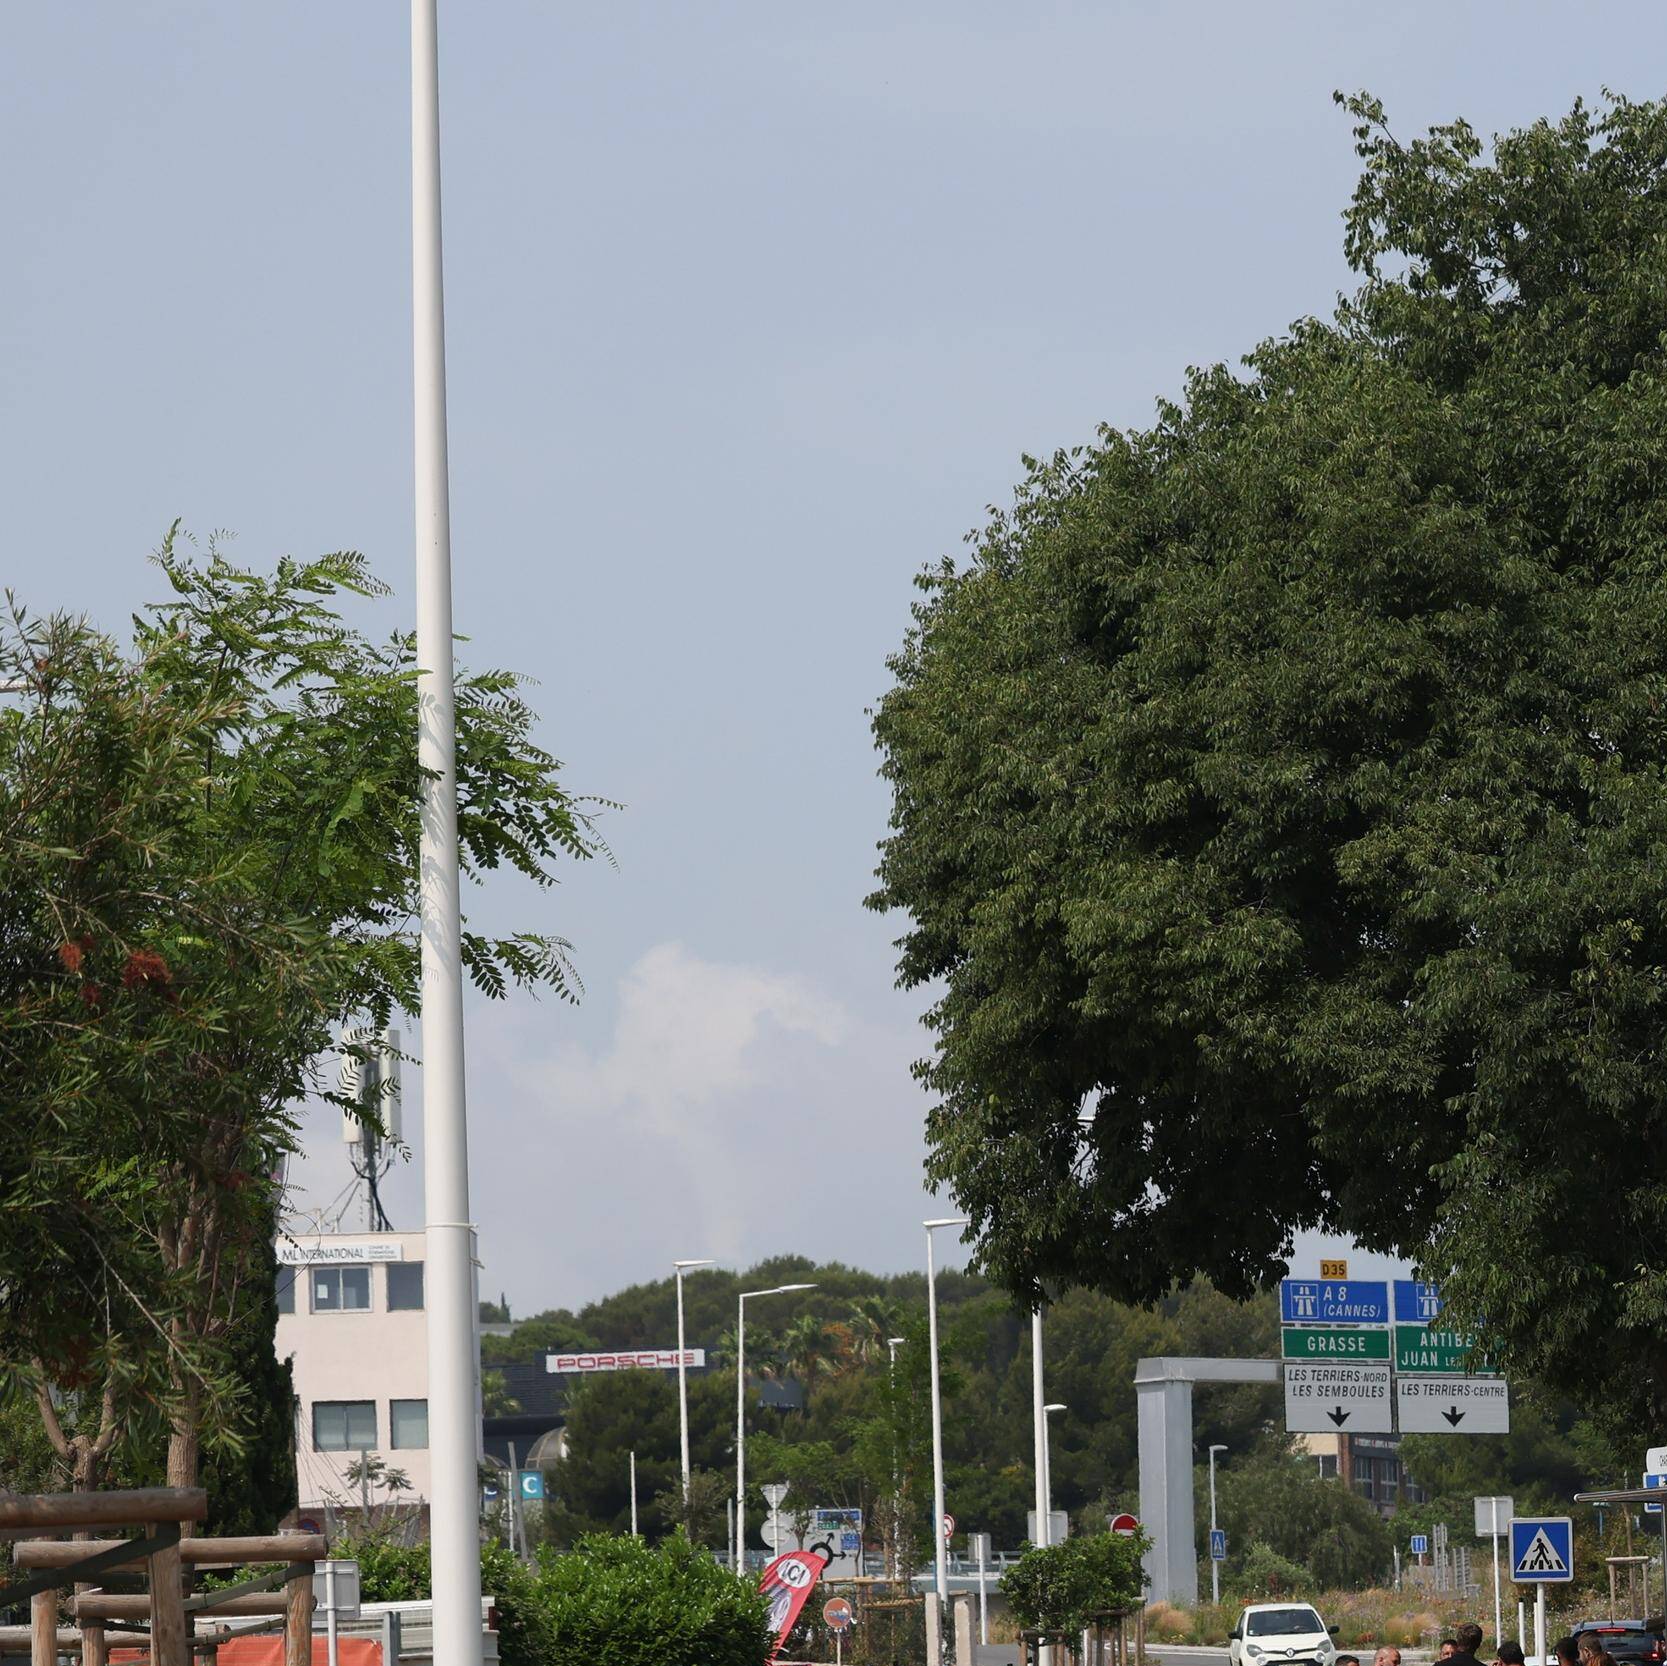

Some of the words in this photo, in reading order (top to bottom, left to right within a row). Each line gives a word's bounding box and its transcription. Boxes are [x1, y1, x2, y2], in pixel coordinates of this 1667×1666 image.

[1323, 1286, 1333, 1301] A
[1338, 1286, 1347, 1301] 8
[1323, 1304, 1381, 1318] (CANNES)
[1307, 1336, 1366, 1352] GRASSE
[1420, 1332, 1478, 1347] ANTIBE
[557, 1352, 695, 1369] PORSCHE
[1401, 1351, 1438, 1367] JUAN
[1289, 1369, 1307, 1381] LES
[1293, 1385, 1312, 1397] LES
[1317, 1385, 1385, 1398] SEMBOULES
[1401, 1384, 1420, 1396] LES
[523, 1476, 537, 1494] C
